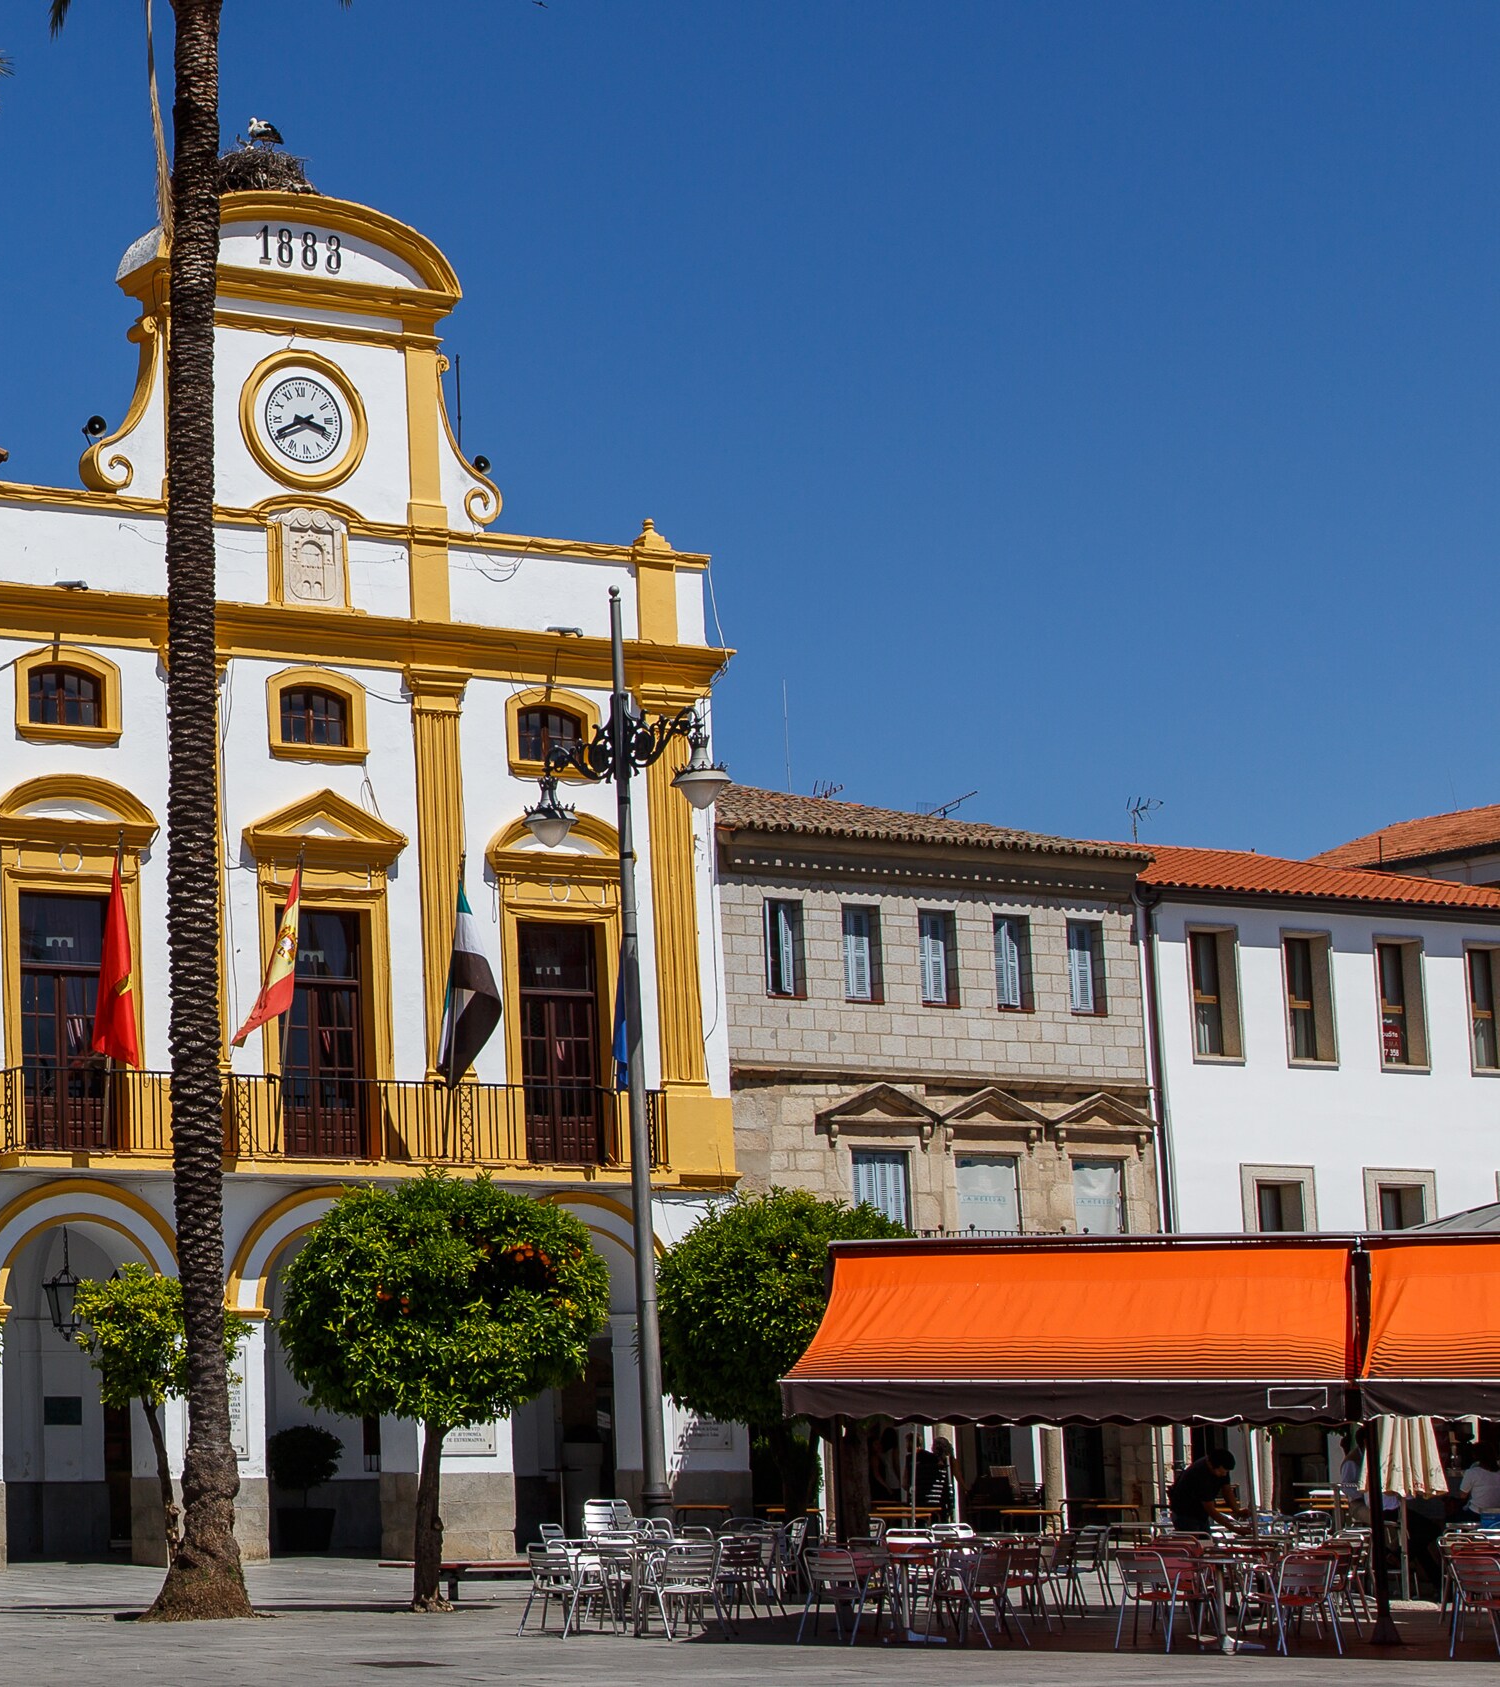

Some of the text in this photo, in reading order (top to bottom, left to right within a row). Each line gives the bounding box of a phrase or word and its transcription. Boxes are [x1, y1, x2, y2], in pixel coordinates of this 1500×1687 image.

[256, 225, 342, 275] 1883
[282, 390, 293, 401] XI
[295, 387, 305, 397] XII
[275, 401, 284, 409] X
[319, 403, 329, 411] II
[273, 415, 282, 423] IX
[288, 439, 297, 452] VII
[303, 444, 311, 454] VI
[316, 442, 323, 451] V
